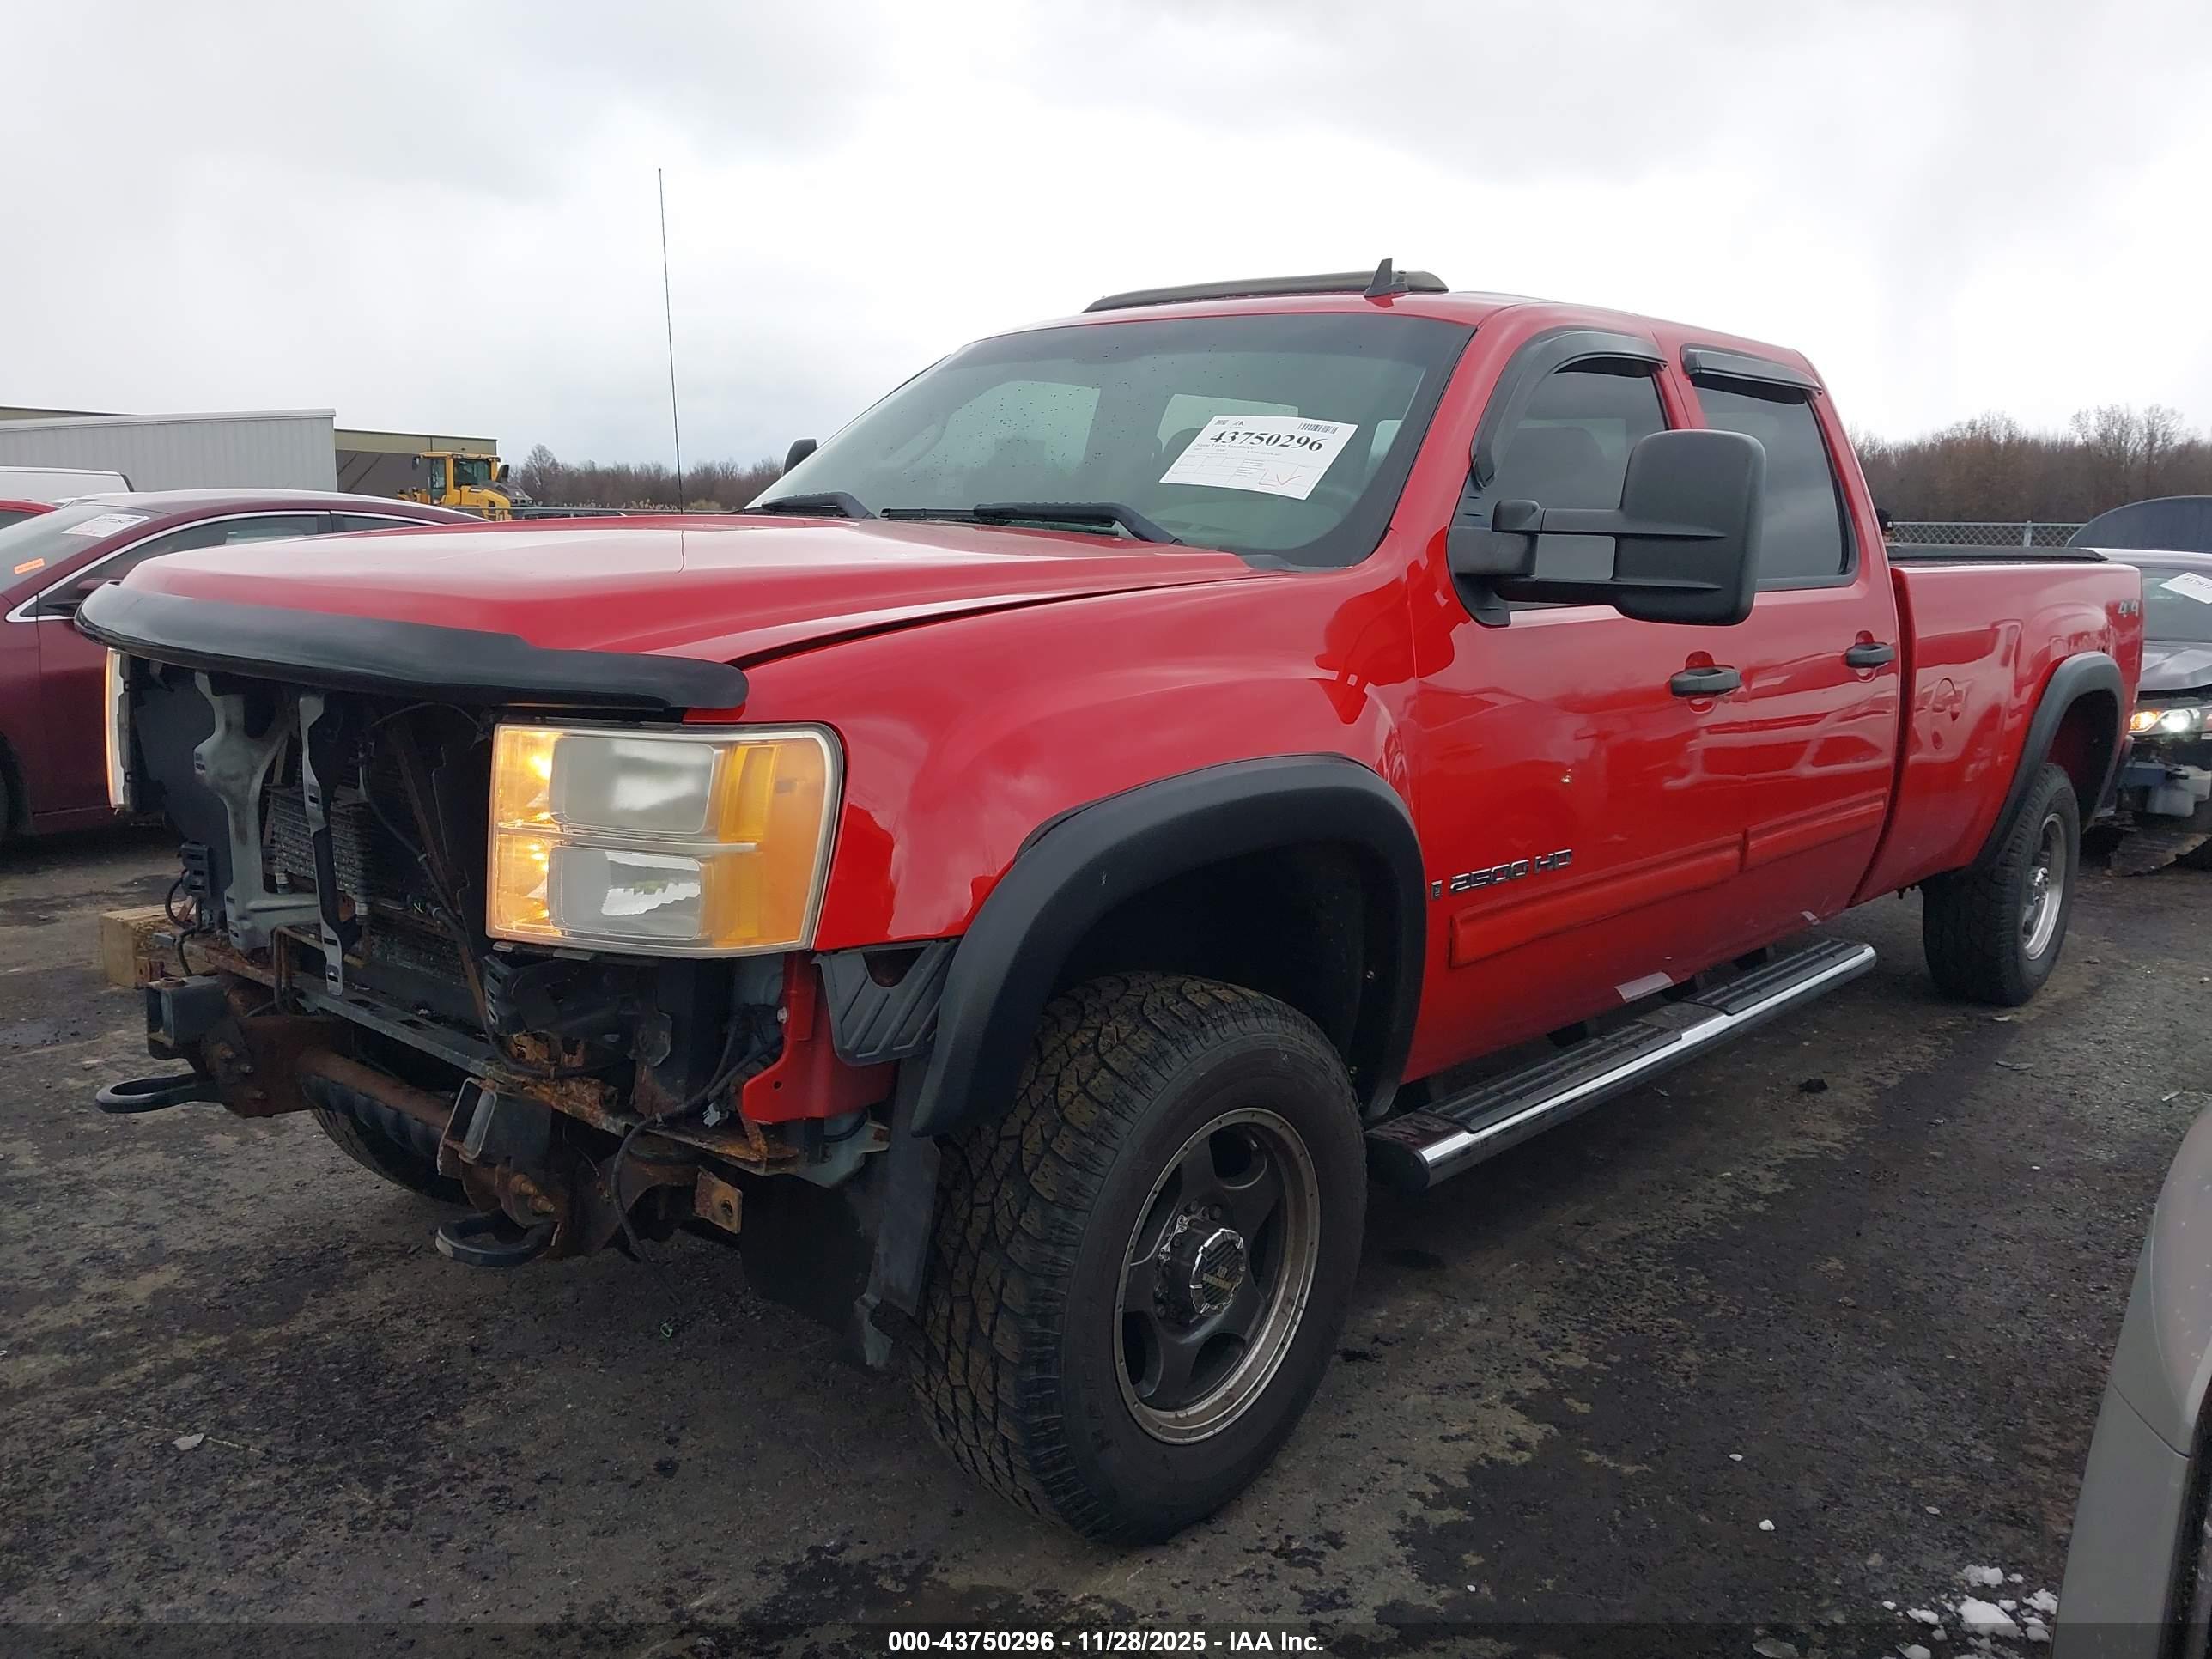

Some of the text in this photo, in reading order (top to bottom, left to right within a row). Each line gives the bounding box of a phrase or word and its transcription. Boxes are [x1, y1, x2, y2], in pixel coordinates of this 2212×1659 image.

[1209, 430, 1328, 451] 43750296
[1449, 859, 1529, 893] 2500
[1534, 848, 1572, 874] HD
